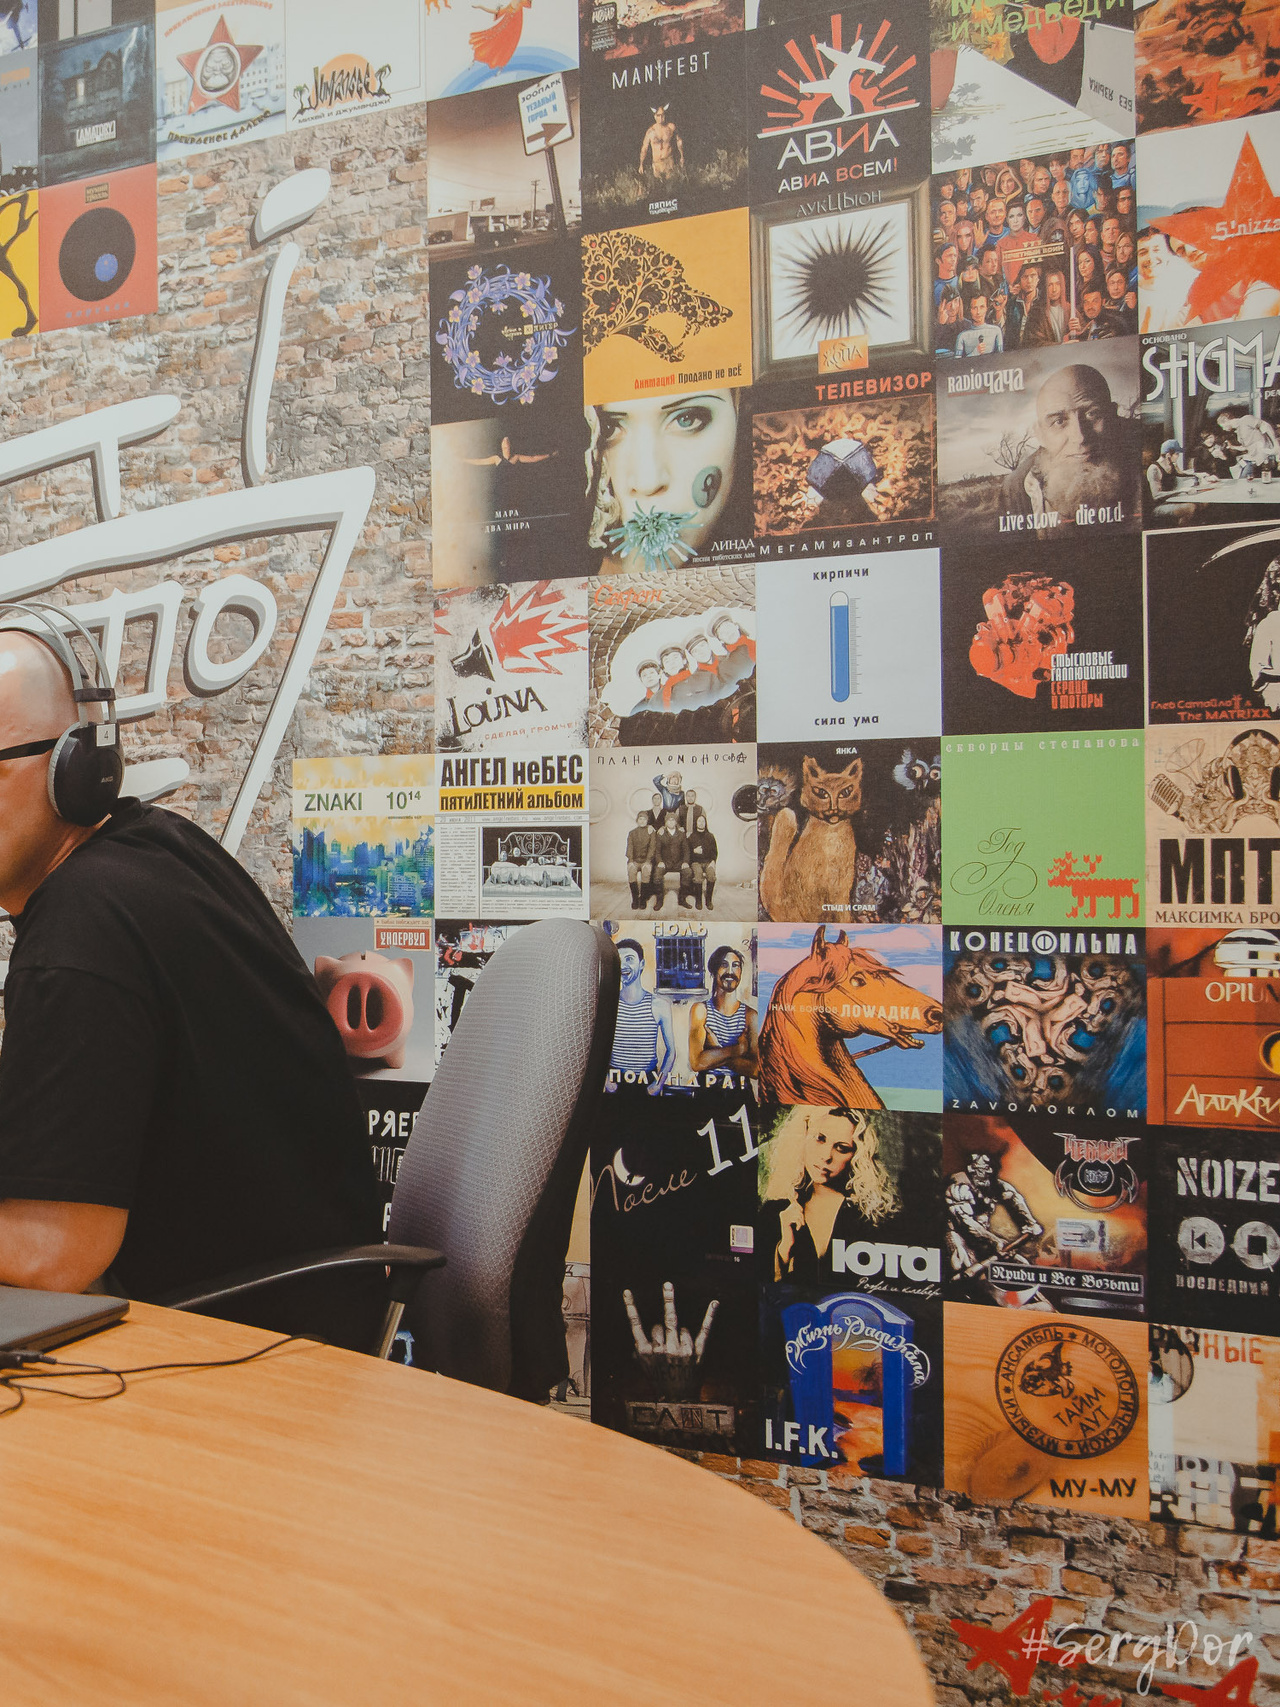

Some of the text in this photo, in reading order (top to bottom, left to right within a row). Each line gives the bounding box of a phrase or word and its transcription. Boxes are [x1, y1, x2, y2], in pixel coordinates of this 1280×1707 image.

[777, 118, 899, 171] АВИА
[778, 157, 898, 194] АВИА ВСЕМ!
[1142, 332, 1187, 345] ОСНОВАНО
[814, 371, 932, 401] ТЕЛЕВИЗОР
[495, 508, 519, 519] МАРА
[505, 520, 531, 531] МИРА
[711, 537, 756, 552] ЛИНДА
[759, 531, 933, 555] МЕГАМИЗАНТРОП
[813, 567, 870, 582] кирпичи
[1051, 651, 1113, 668] СМЫСЛОВЫЕ
[814, 715, 880, 727] сила ума
[835, 746, 858, 756] ЯНКА
[945, 735, 1140, 755] скворцы степанова
[597, 754, 640, 766] ПЛАН
[440, 753, 584, 788] АНГЕЛ неБЕС
[304, 792, 364, 812] ZNAKI
[527, 790, 583, 810] альбом
[822, 903, 843, 912] СТЫД
[852, 903, 876, 912] СРАМ
[1155, 910, 1244, 925] МАКСИМКА
[380, 931, 426, 947] УНДЕРВУД
[652, 921, 708, 938] НОЛЬ
[1177, 1157, 1280, 1204] NOIZE
[1176, 1274, 1269, 1298] ПОСЛЕДНИЙ
[1053, 1386, 1107, 1428] ТАЙМ
[1079, 1405, 1111, 1439] АУТ
[765, 1417, 839, 1460] I.F.K.
[1050, 1477, 1137, 1499] МУ-МУ
